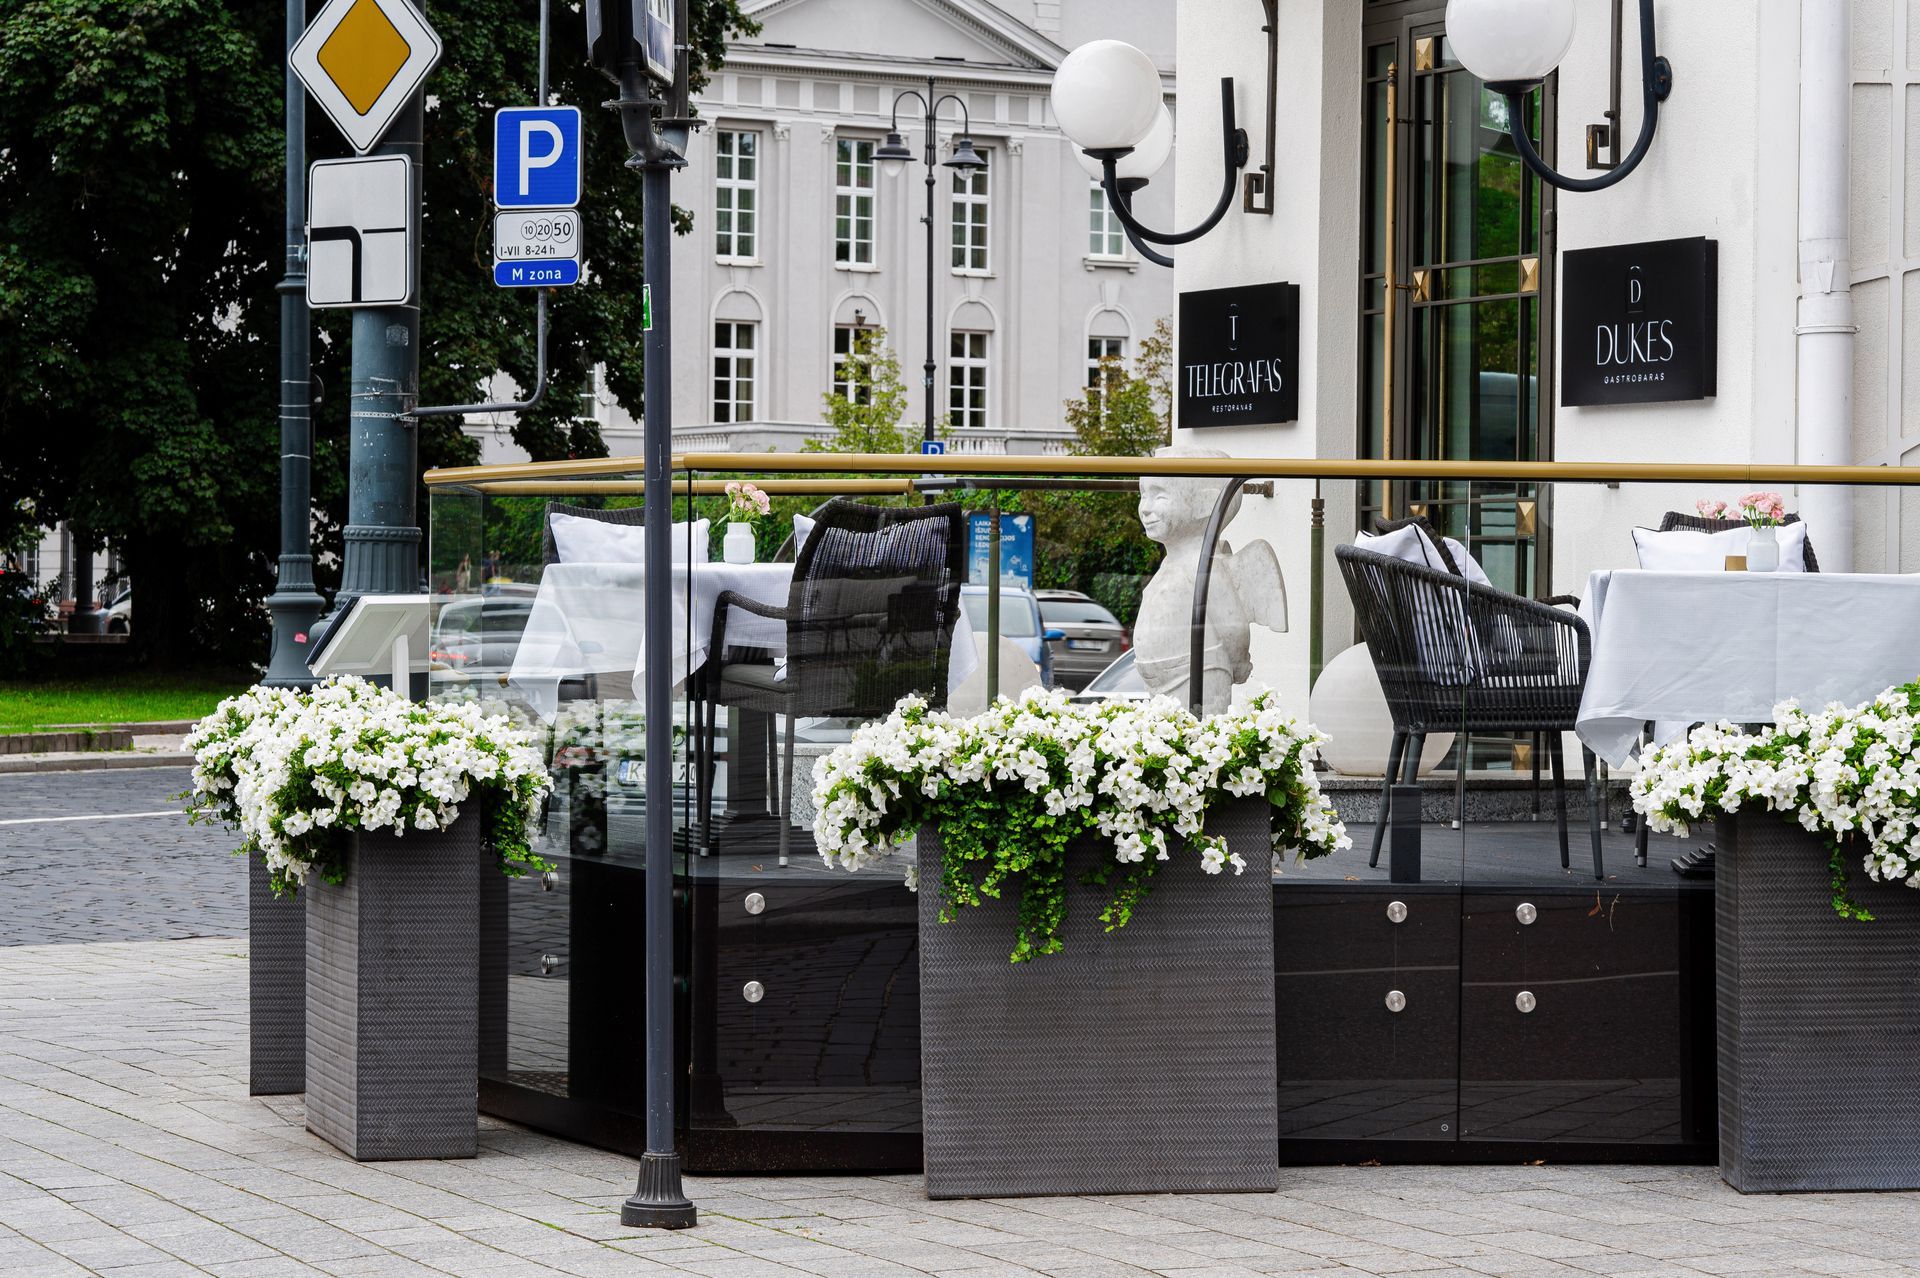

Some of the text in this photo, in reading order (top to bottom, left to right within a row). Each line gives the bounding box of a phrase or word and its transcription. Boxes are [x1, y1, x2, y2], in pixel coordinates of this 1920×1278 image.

[519, 120, 564, 196] P
[524, 222, 571, 237] 10 20 50
[500, 244, 556, 256] I-VII 8-24 h
[512, 267, 562, 281] M zona
[1630, 279, 1642, 304] D
[1229, 315, 1239, 341] T
[1596, 319, 1674, 366] DUKES
[1185, 358, 1282, 398] TELEGRAFAS
[1603, 372, 1666, 385] GASTROBARAS
[1212, 403, 1253, 413] RESTORANAS
